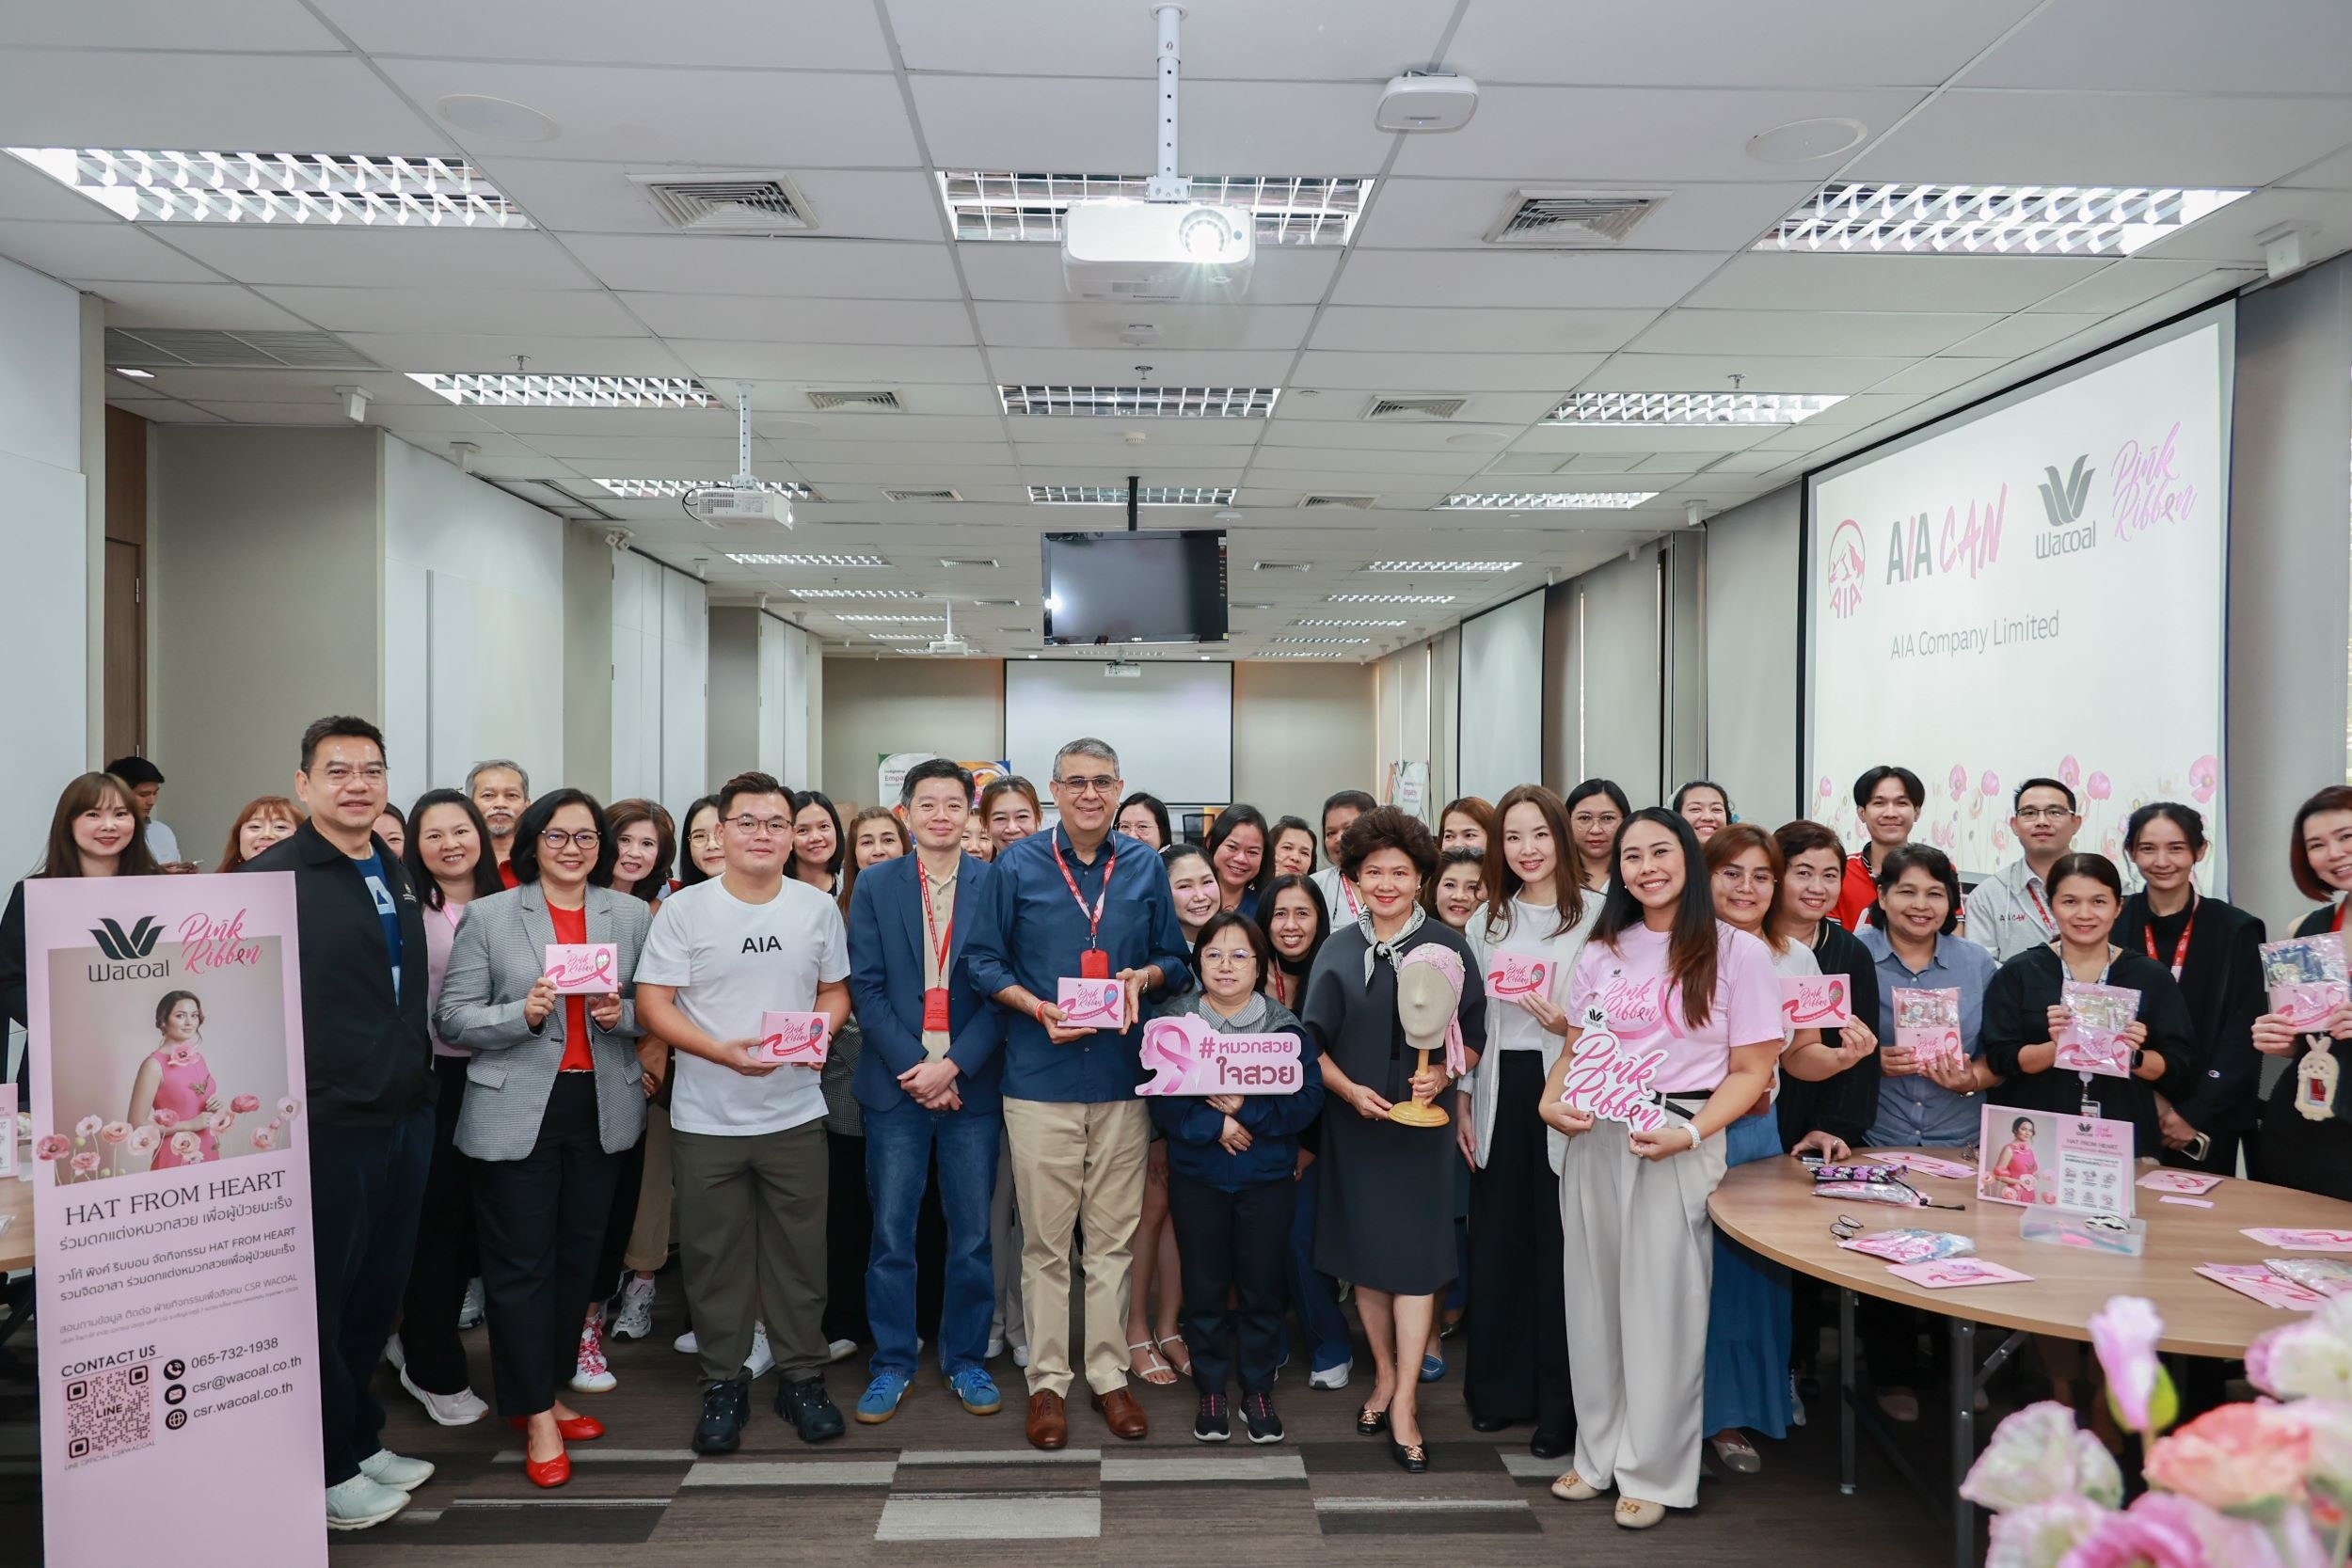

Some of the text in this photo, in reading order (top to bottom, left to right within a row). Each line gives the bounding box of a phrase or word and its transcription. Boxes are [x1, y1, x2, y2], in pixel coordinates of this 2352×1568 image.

[2110, 420, 2182, 497] Pink
[2110, 482, 2200, 543] Ribbon
[1886, 482, 2008, 585] AIA CAN
[2035, 522, 2097, 560] Wacoal
[1829, 583, 1863, 620] AIA
[1890, 609, 2060, 660] AIA Company Limited
[178, 907, 248, 944] Pink
[182, 938, 263, 975] Ribbon
[740, 934, 783, 955] AIA
[87, 958, 169, 983] Wacoal
[1604, 976, 1656, 1002] Pink
[1216, 1055, 1295, 1085] ใจสวย
[1576, 1033, 1664, 1097] Pink
[1565, 1067, 1663, 1132] Ribbon
[65, 1169, 286, 1226] HAT FROM HEART
[59, 1195, 293, 1251] ร่วมตกแต่งหมวกสวย เพื่อผู้ป่วยมะเร็ง
[58, 1267, 83, 1284] วาโก้
[152, 1246, 206, 1265] จัดกิจกรรม
[209, 1240, 230, 1252] HAT
[231, 1234, 262, 1248] FROM
[263, 1227, 296, 1241] HEART
[245, 1281, 262, 1292] CSR
[263, 1274, 298, 1288] WACOAL
[61, 1344, 156, 1378] CONTACT US
[191, 1337, 278, 1370] 065-732-1938
[192, 1355, 302, 1394] csr@wacoal.co.th
[96, 1403, 123, 1418] LINE
[193, 1383, 294, 1418] csr.wacoal.co.th
